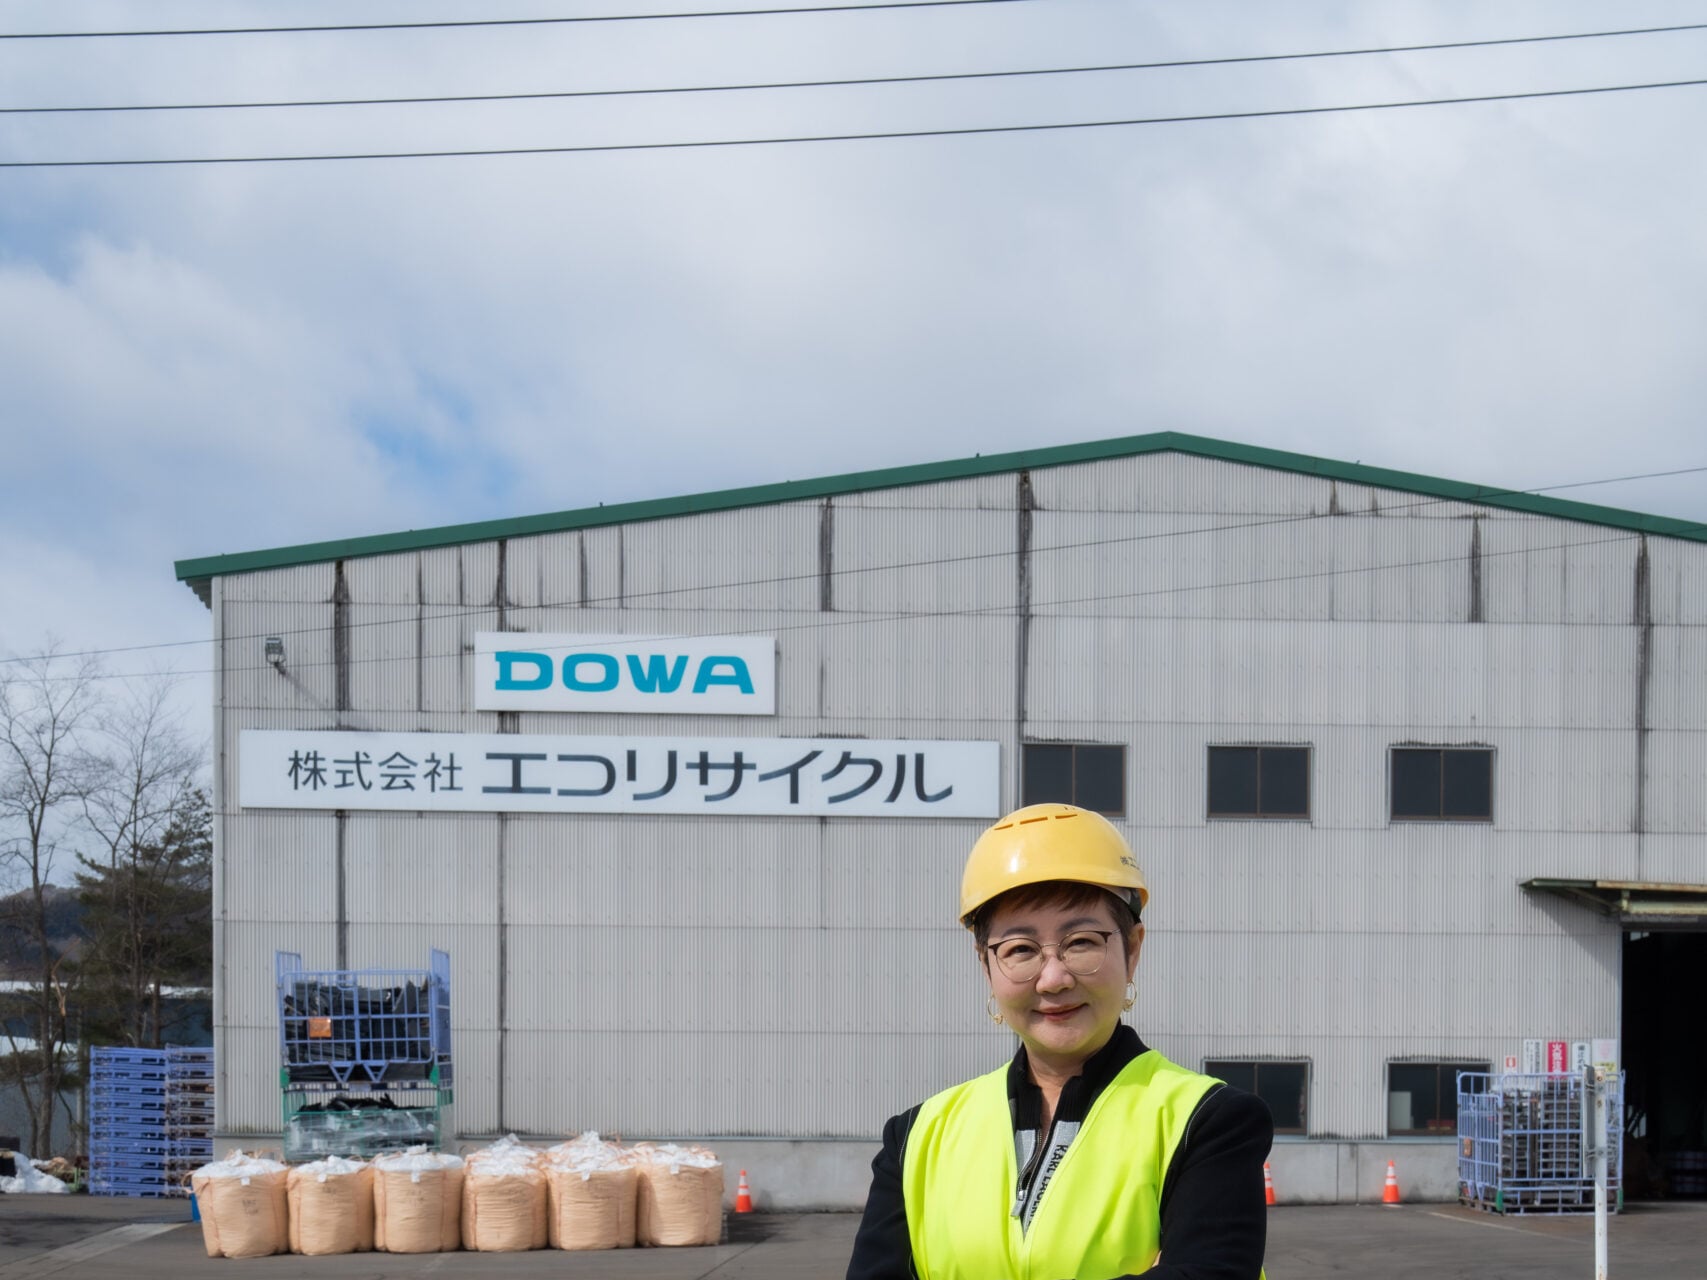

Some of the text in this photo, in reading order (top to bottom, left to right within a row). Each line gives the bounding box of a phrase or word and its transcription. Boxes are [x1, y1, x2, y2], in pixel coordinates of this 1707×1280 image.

[494, 650, 756, 695] DOWA
[287, 749, 953, 805] 株式会社 エコリサイクル
[1047, 1143, 1069, 1173] KARL
